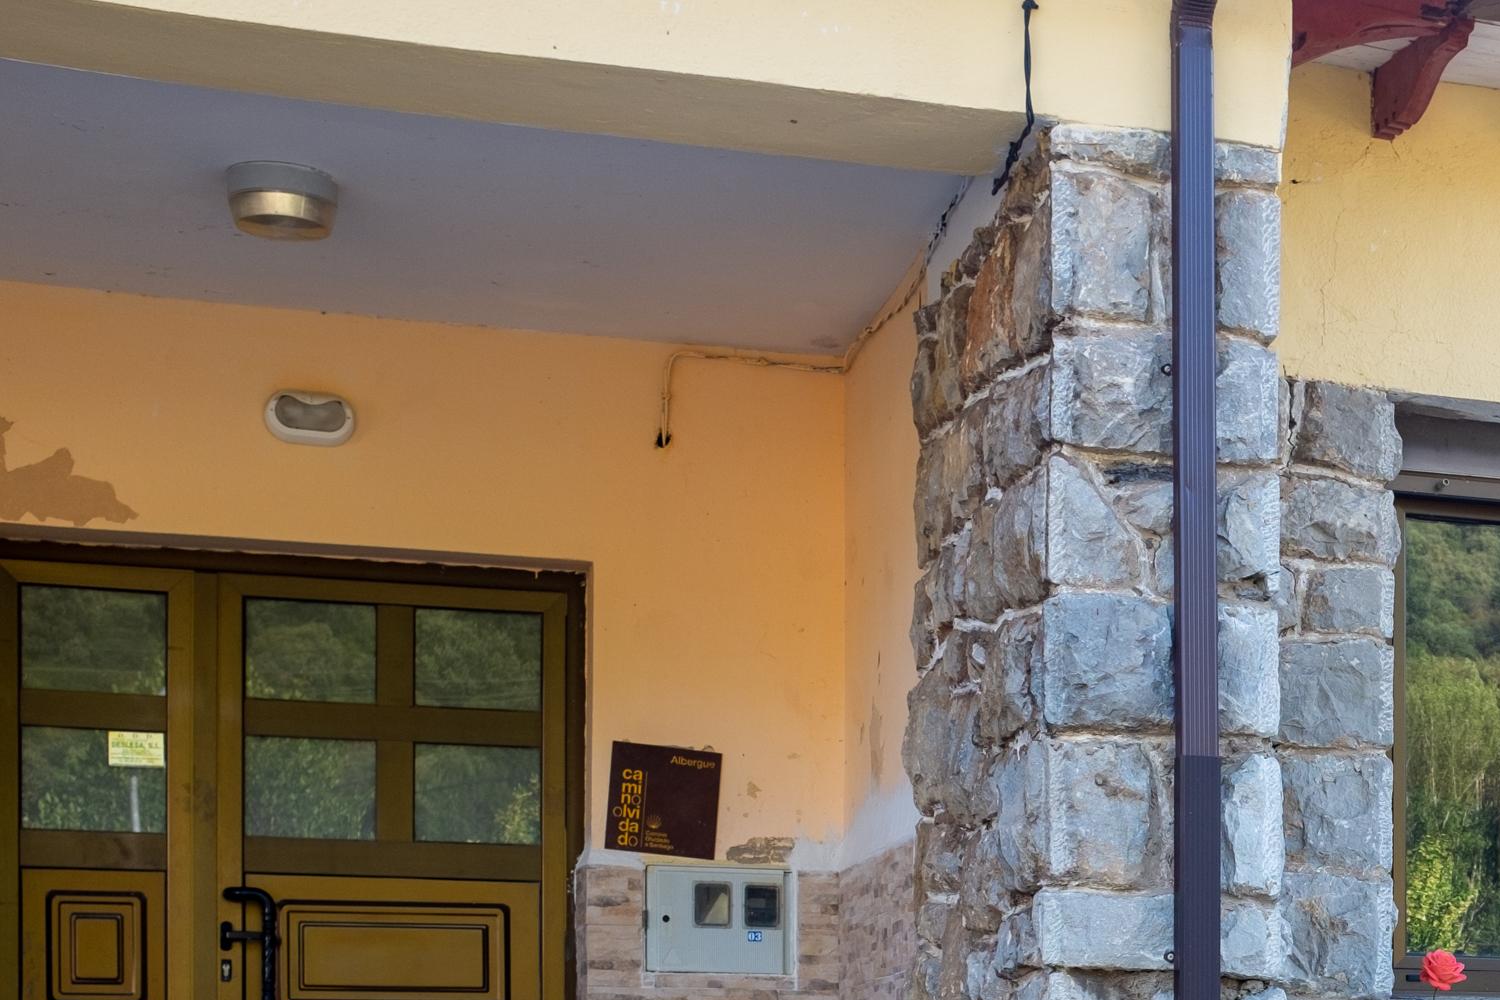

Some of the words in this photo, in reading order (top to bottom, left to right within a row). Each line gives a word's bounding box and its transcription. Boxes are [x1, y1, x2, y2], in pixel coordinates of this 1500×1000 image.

[670, 756, 715, 769] Albergue
[622, 768, 643, 781] ca
[622, 780, 642, 793] mi
[620, 792, 641, 805] no
[612, 804, 640, 820] olvi
[618, 819, 639, 833] da
[617, 832, 639, 847] do
[748, 931, 762, 942] 03
